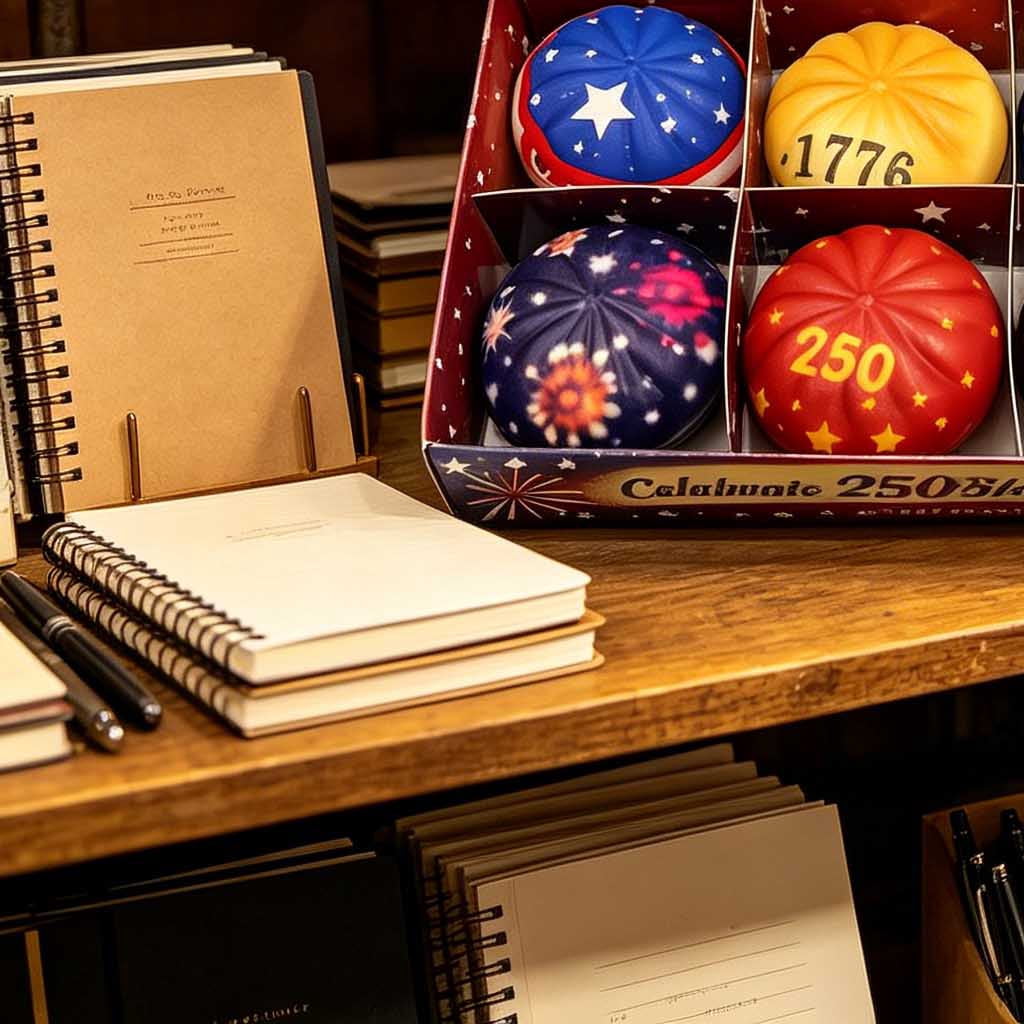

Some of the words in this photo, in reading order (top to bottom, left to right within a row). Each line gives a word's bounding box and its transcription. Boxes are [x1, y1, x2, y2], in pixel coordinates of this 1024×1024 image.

[794, 133, 915, 186] 1776
[789, 325, 896, 393] 250
[836, 474, 961, 499] 250
